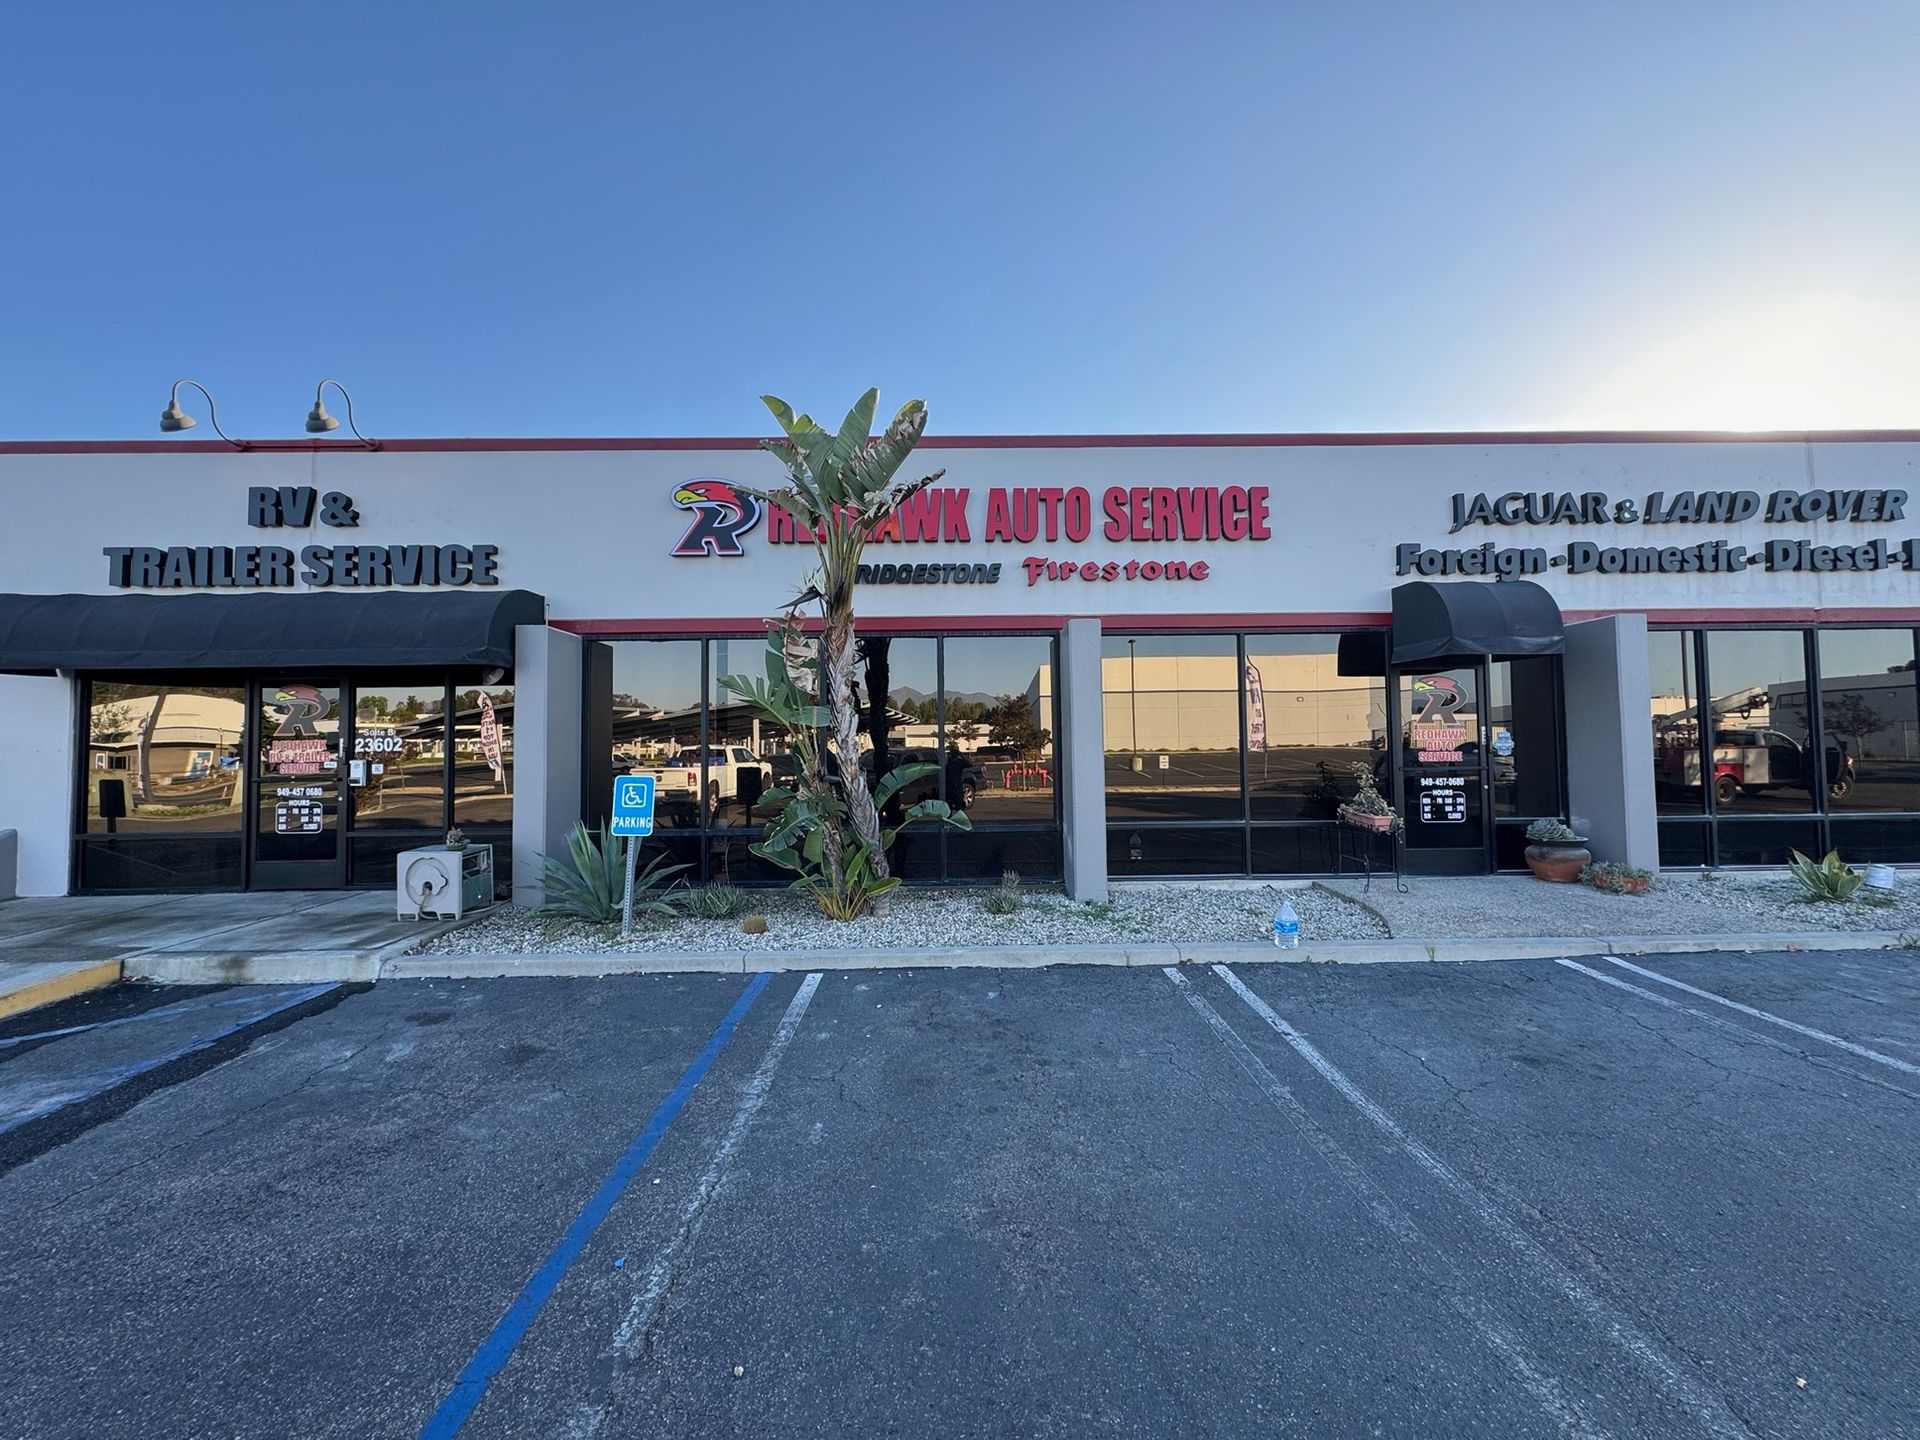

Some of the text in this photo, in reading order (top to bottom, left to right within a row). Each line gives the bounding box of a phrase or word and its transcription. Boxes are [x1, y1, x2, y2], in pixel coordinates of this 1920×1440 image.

[248, 486, 360, 527] RV &
[1449, 489, 1908, 534] JAGUAR & LAND ROVER
[984, 486, 1091, 543] AUTO
[1103, 485, 1271, 543] SERVICE
[103, 544, 499, 587] TRAILER SERVICE
[1022, 556, 1210, 587] Firestone
[853, 563, 1002, 585] RIDGESTONE
[1414, 729, 1467, 740] REDHAWK
[272, 740, 327, 750] REDHAWK
[354, 738, 403, 752] 23602
[1426, 740, 1455, 751] AUTO
[293, 751, 330, 762] TRAILER
[1418, 751, 1463, 762] SERVICE
[280, 763, 320, 774] SERVICE
[1420, 777, 1464, 786] 949-457-0680
[613, 816, 652, 829] PARKING
